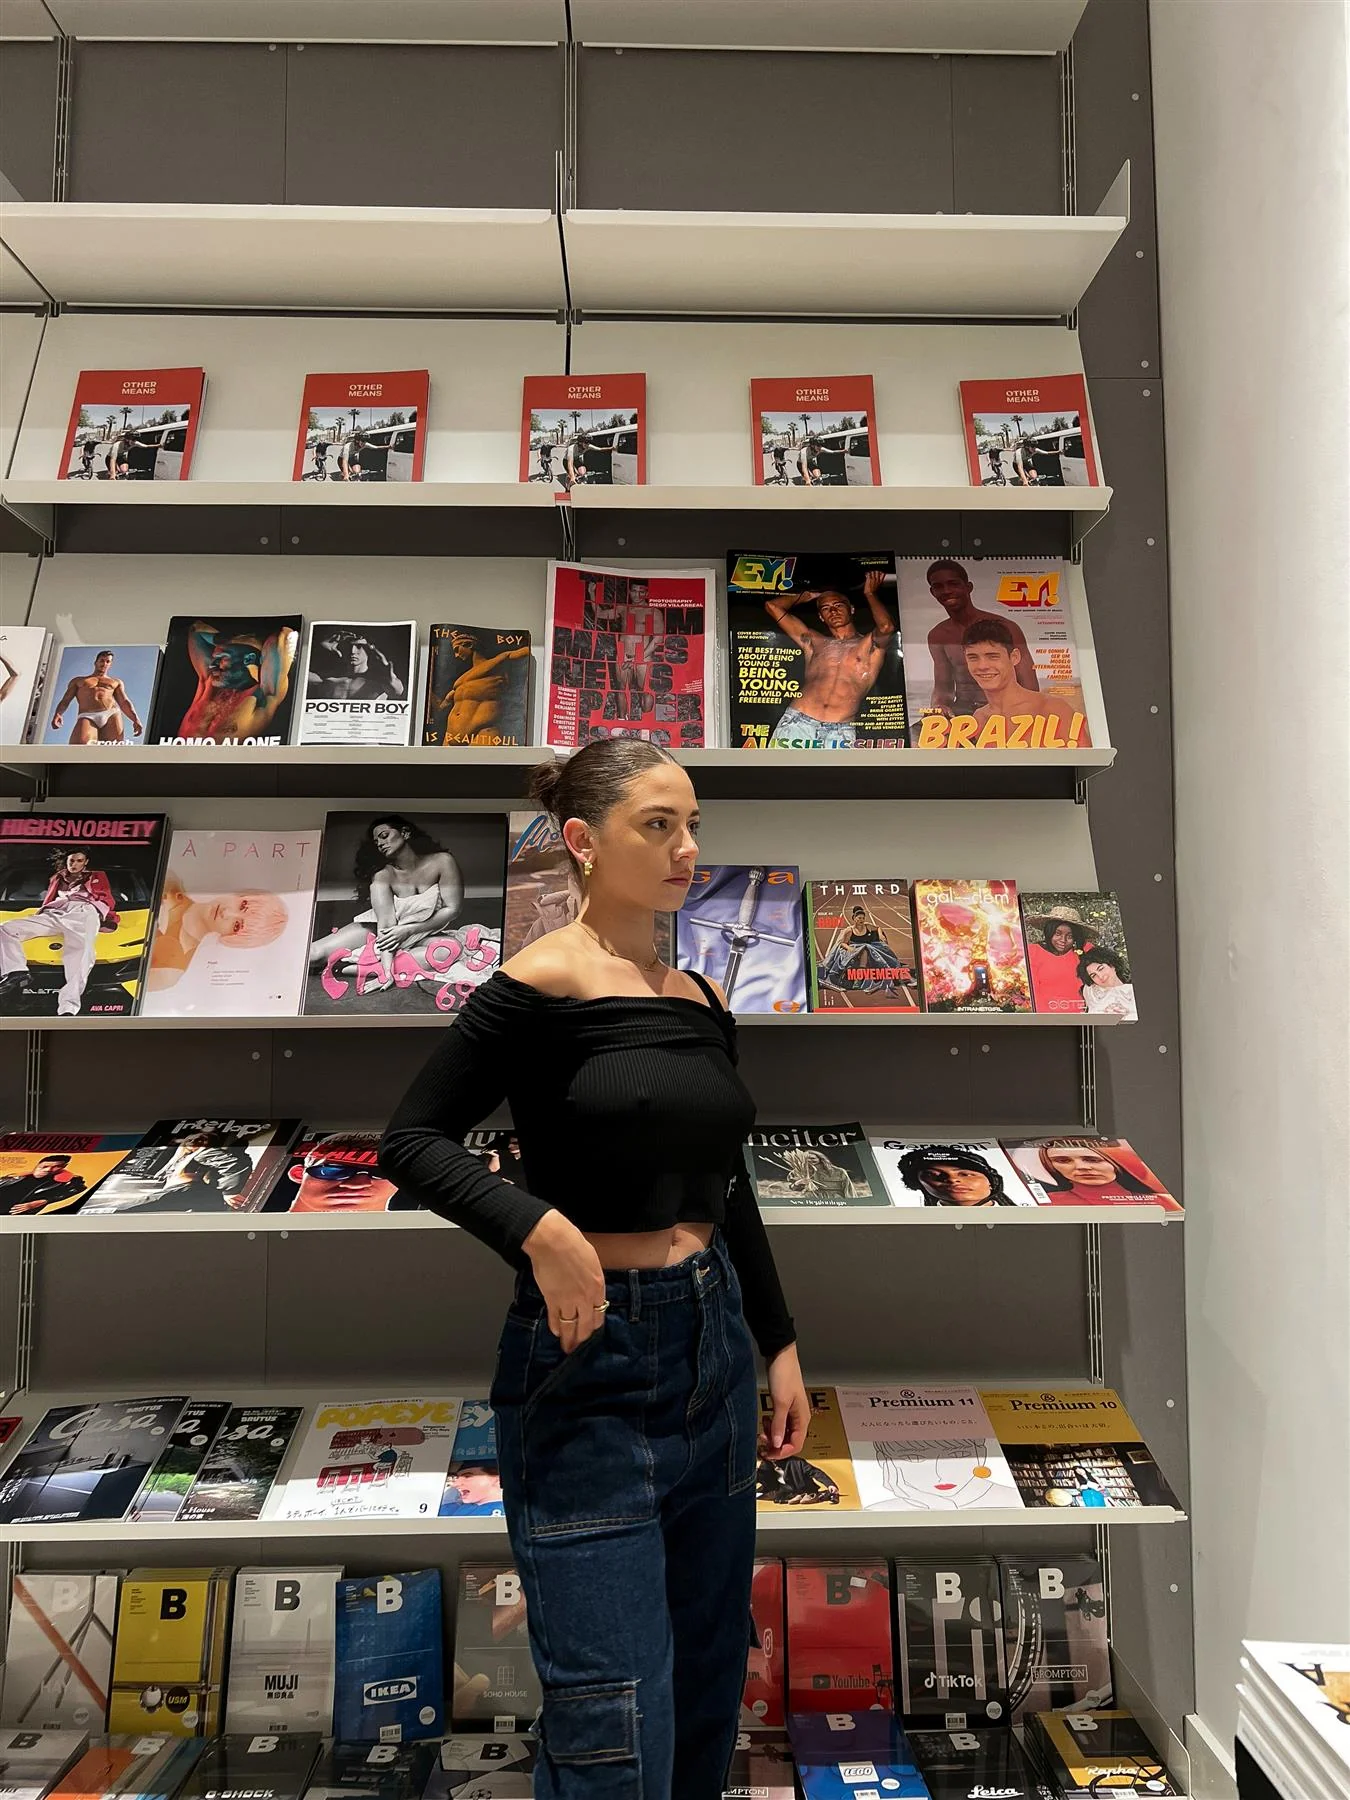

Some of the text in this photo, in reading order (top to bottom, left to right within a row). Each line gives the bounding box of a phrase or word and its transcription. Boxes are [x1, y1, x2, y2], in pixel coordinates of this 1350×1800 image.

[434, 628, 522, 645] THE BOY
[739, 667, 786, 679] BEING
[739, 679, 799, 691] YOUNG
[305, 702, 409, 714] POSTER BOY
[425, 732, 438, 743] IS
[740, 724, 770, 737] THE
[918, 712, 1084, 748] BRAZIL!
[0, 818, 157, 838] HIGHSNOBIETY
[182, 839, 310, 858] A PART
[847, 968, 912, 980] MOVEMENTS
[870, 1396, 955, 1408] Premium
[1009, 1399, 1117, 1412] Premium 10
[49, 1408, 158, 1440] Casa
[316, 1401, 456, 1430] POPEYE
[419, 1503, 428, 1513] 9
[496, 1574, 522, 1606] B
[827, 1574, 851, 1604] B
[936, 1572, 962, 1604] B
[1039, 1568, 1065, 1599] B
[53, 1582, 79, 1612] B
[160, 1588, 188, 1620] B
[274, 1580, 301, 1611] B
[377, 1580, 403, 1614] B
[265, 1674, 299, 1690] MUJI
[832, 1674, 870, 1688] YouTube
[939, 1675, 983, 1689] TikTok
[1034, 1668, 1085, 1679] BROMPTON
[370, 1684, 411, 1698] IKEA
[168, 1696, 187, 1704] USM
[826, 1714, 856, 1731] B
[1066, 1714, 1098, 1731] B
[7, 1733, 43, 1749] B
[130, 1738, 166, 1755] B
[248, 1736, 280, 1753] B
[949, 1733, 980, 1750] B
[366, 1746, 399, 1763] B
[480, 1743, 509, 1760] B
[844, 1768, 872, 1776] LEGO
[1086, 1766, 1138, 1778] Rapha
[205, 1789, 274, 1799] G-SHOCK
[967, 1785, 1024, 1798] Leica
